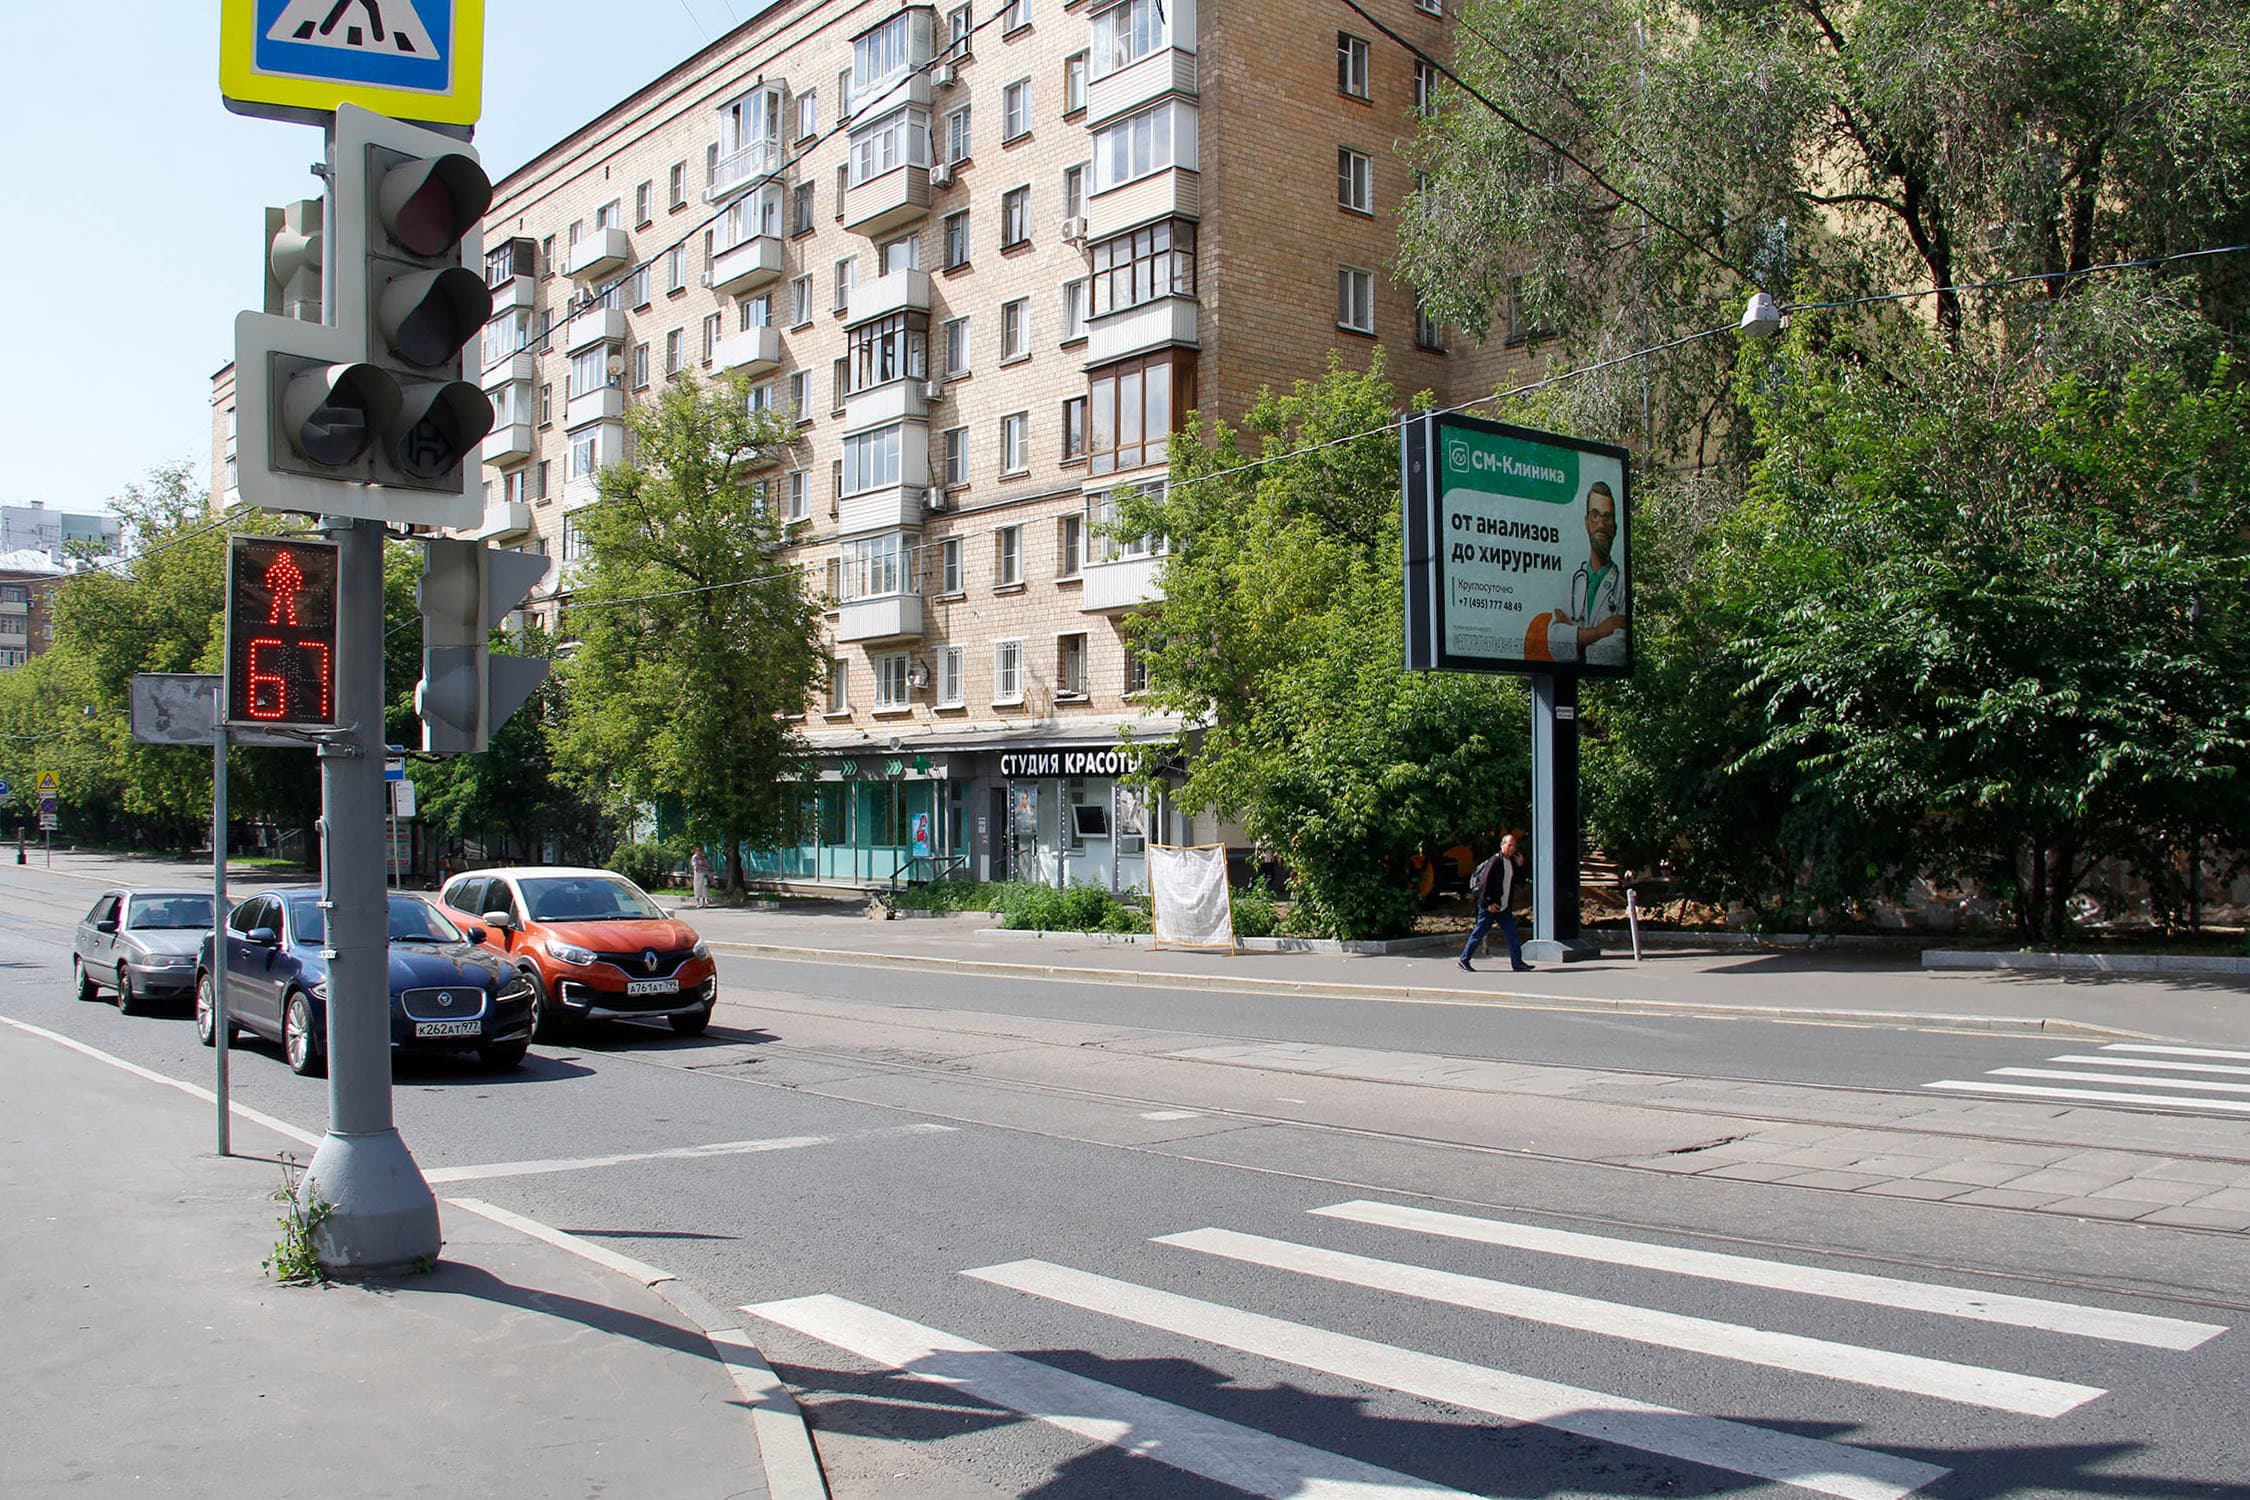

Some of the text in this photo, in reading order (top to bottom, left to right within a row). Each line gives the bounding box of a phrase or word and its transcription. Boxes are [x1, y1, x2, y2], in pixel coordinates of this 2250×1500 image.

[1472, 450, 1565, 483] СМ-Клиника
[1451, 513, 1559, 543] от анализов
[1451, 542, 1561, 573] до хирургии
[1457, 578, 1514, 594] Круглосуточно
[1469, 597, 1488, 610] (495)
[1490, 600, 1502, 610] 777
[1504, 601, 1513, 611] 48
[248, 638, 328, 718] 67
[1000, 753, 1059, 775] СТУДИЯ
